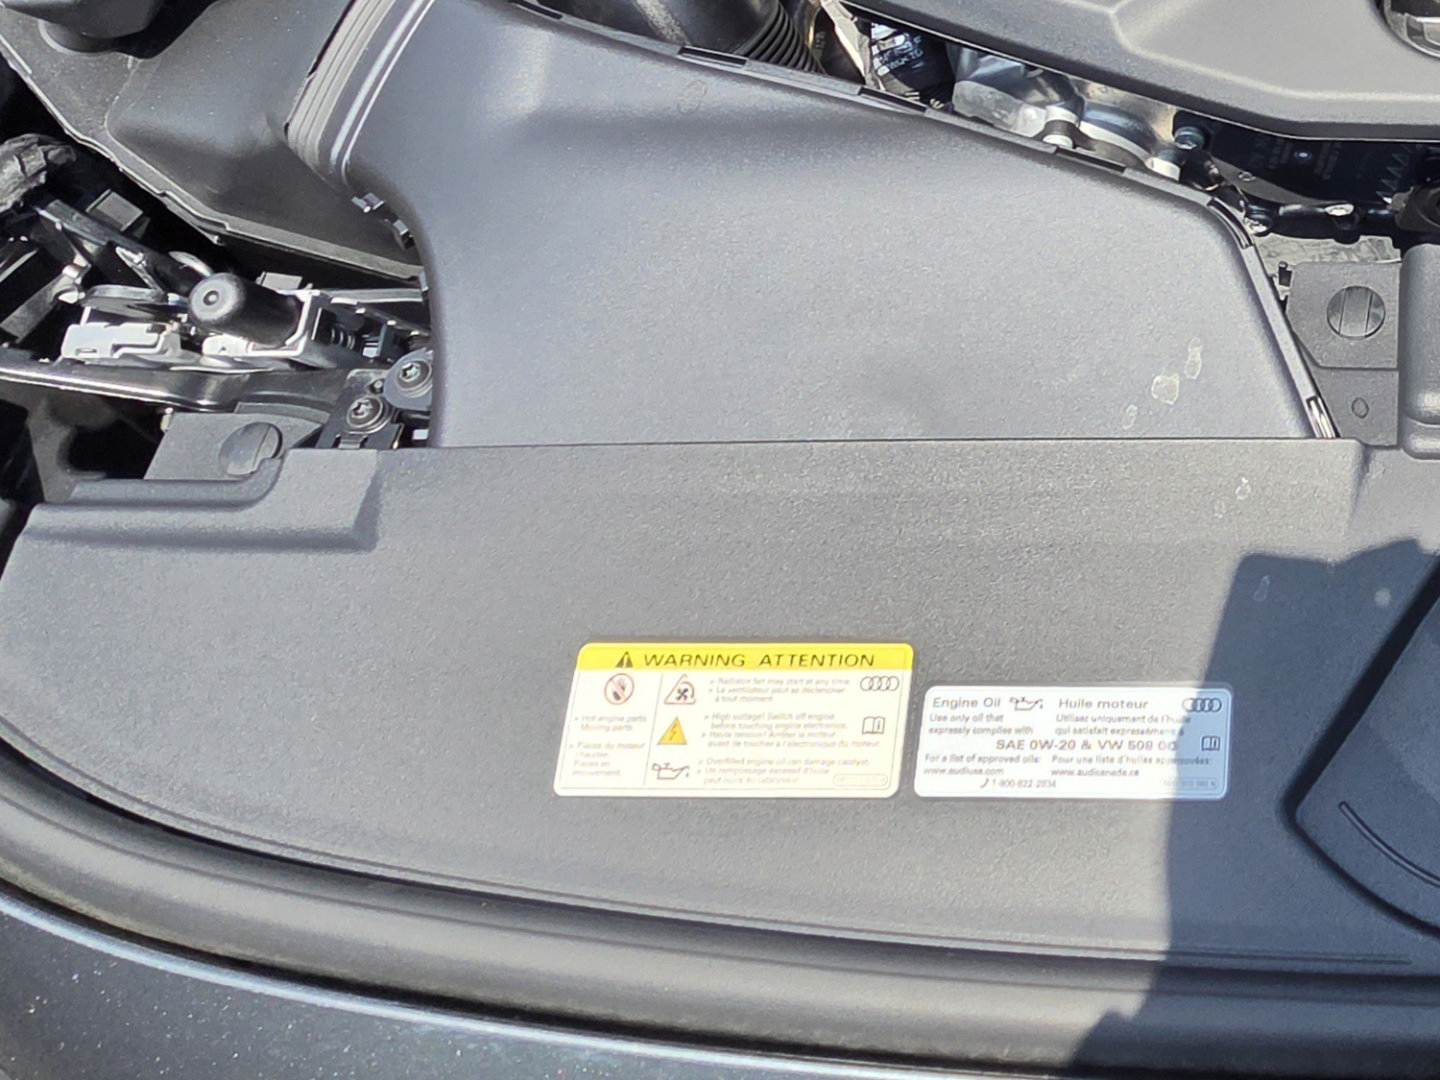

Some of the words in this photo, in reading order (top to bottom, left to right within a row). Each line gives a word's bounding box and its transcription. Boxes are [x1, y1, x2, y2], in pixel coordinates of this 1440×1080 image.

[644, 653, 746, 667] WARNING
[759, 654, 875, 667] ATTENTION
[932, 697, 978, 710] Engine
[983, 697, 1002, 708] Oil
[1058, 698, 1092, 709] Huile
[1096, 700, 1148, 709] moteur
[929, 713, 948, 722] Use
[949, 713, 970, 724] only
[972, 713, 984, 722] oil
[985, 713, 1004, 722] that
[996, 739, 1025, 750] SAE
[1029, 739, 1076, 750] 0W-20
[1081, 740, 1092, 750] &
[1097, 740, 1124, 750] VW
[1127, 740, 1153, 751] 508
